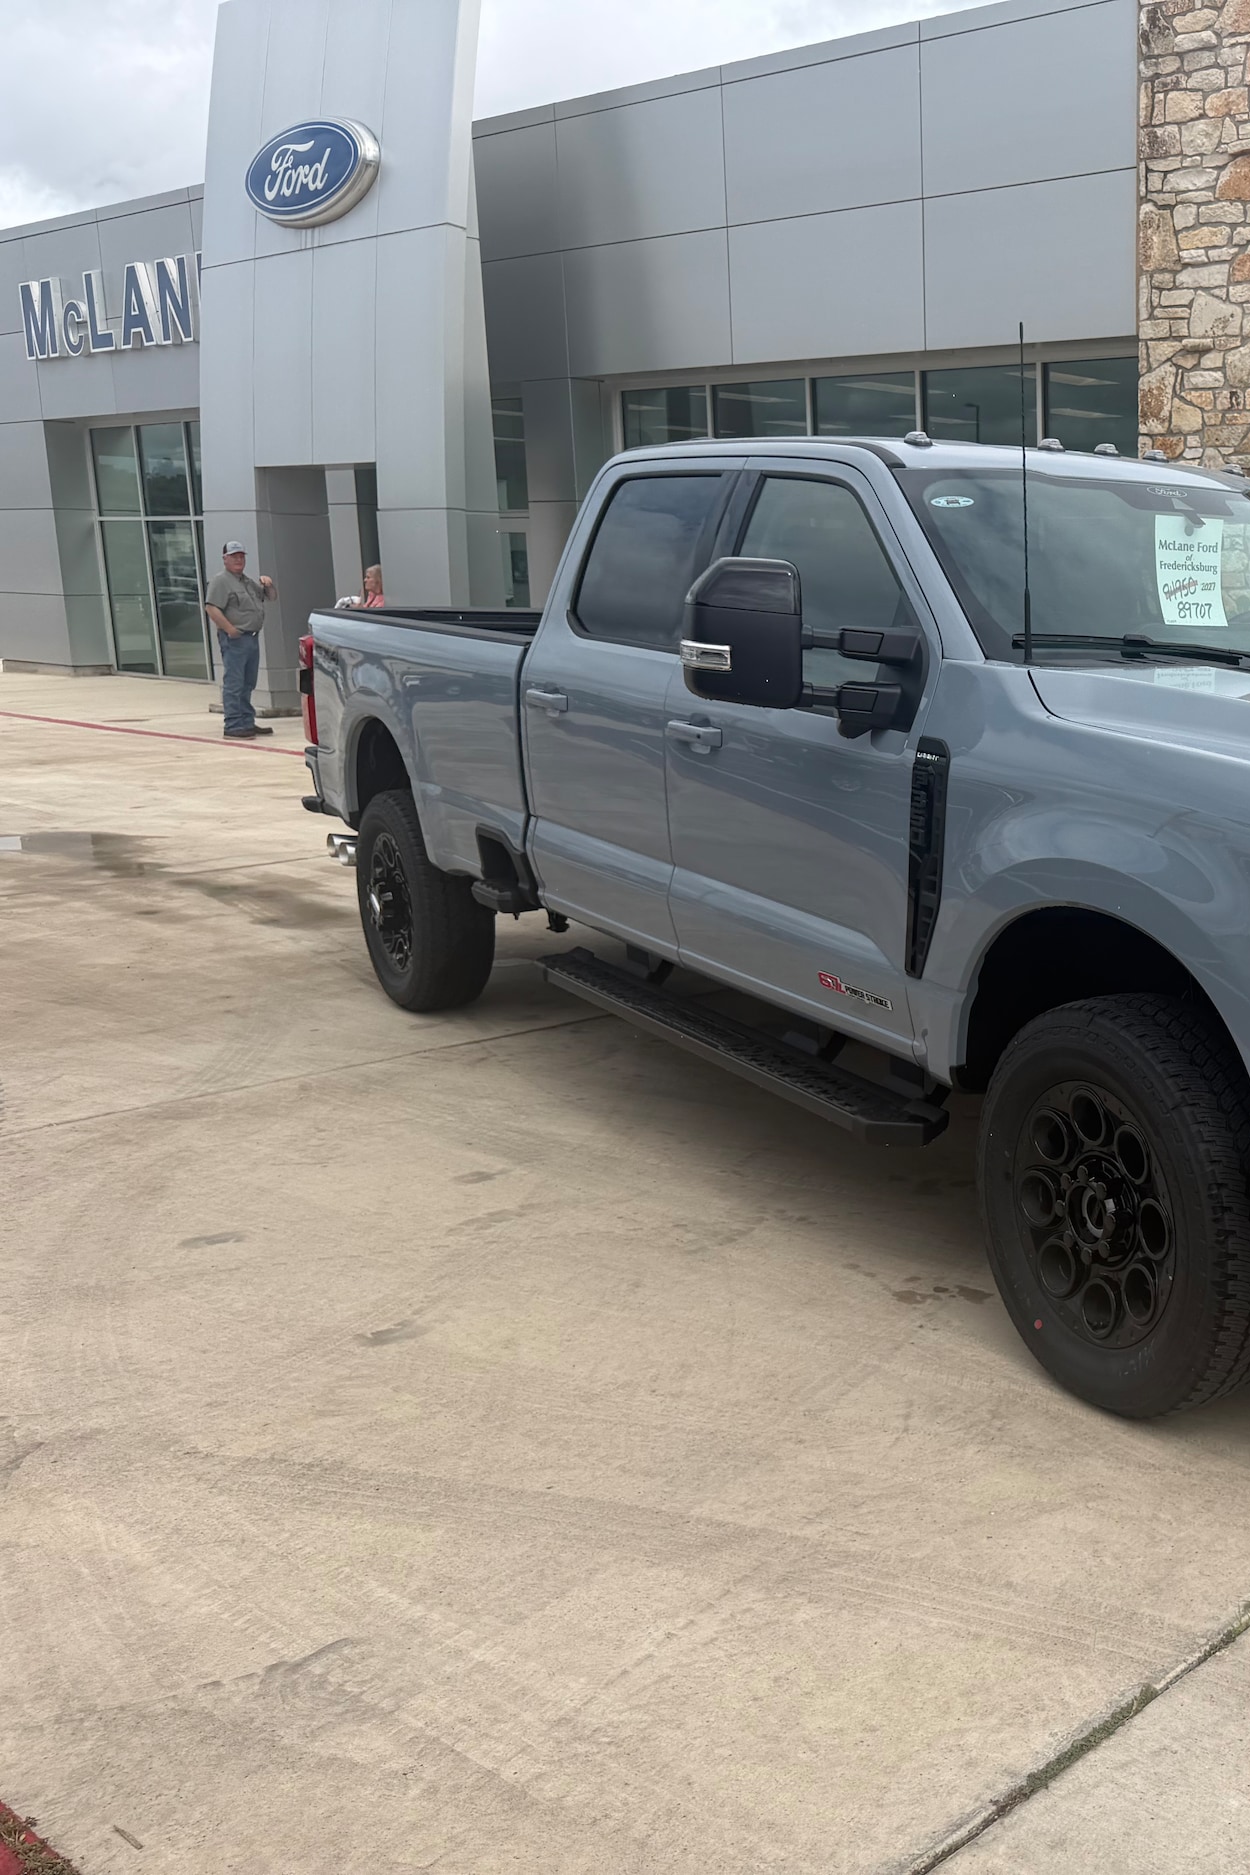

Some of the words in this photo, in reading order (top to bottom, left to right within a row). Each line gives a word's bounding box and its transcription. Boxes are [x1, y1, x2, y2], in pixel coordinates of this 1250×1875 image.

[264, 140, 331, 201] Ford
[18, 251, 201, 361] McLAN
[1158, 539, 1195, 552] McLane
[1197, 541, 1219, 554] Ford
[1185, 553, 1193, 562] of
[1159, 560, 1218, 576] Fredericksburg
[1177, 601, 1213, 620] 89707
